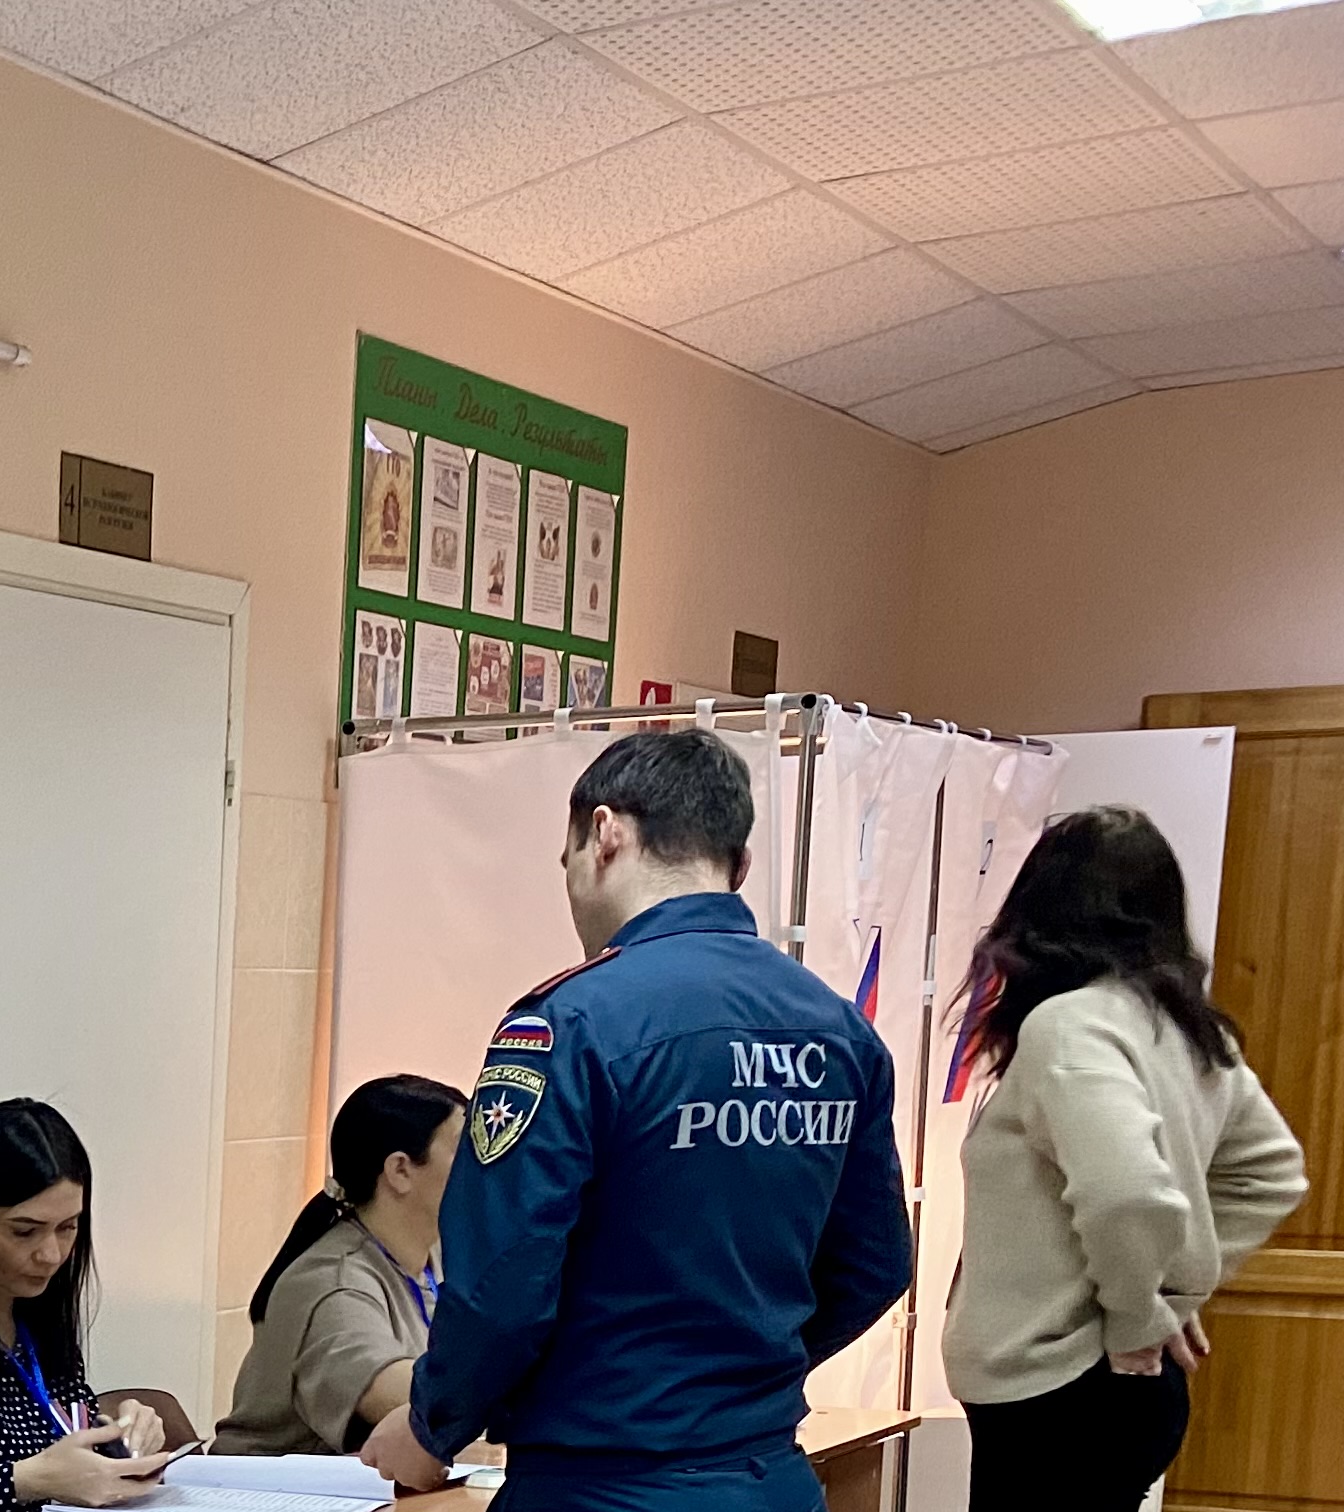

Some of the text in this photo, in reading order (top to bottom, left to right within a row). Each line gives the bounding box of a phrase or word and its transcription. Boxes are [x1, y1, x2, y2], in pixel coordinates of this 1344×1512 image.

[64, 484, 75, 515] 4
[979, 838, 994, 875] 2
[728, 1040, 827, 1090] МЧС
[669, 1099, 858, 1151] РОССИИ
